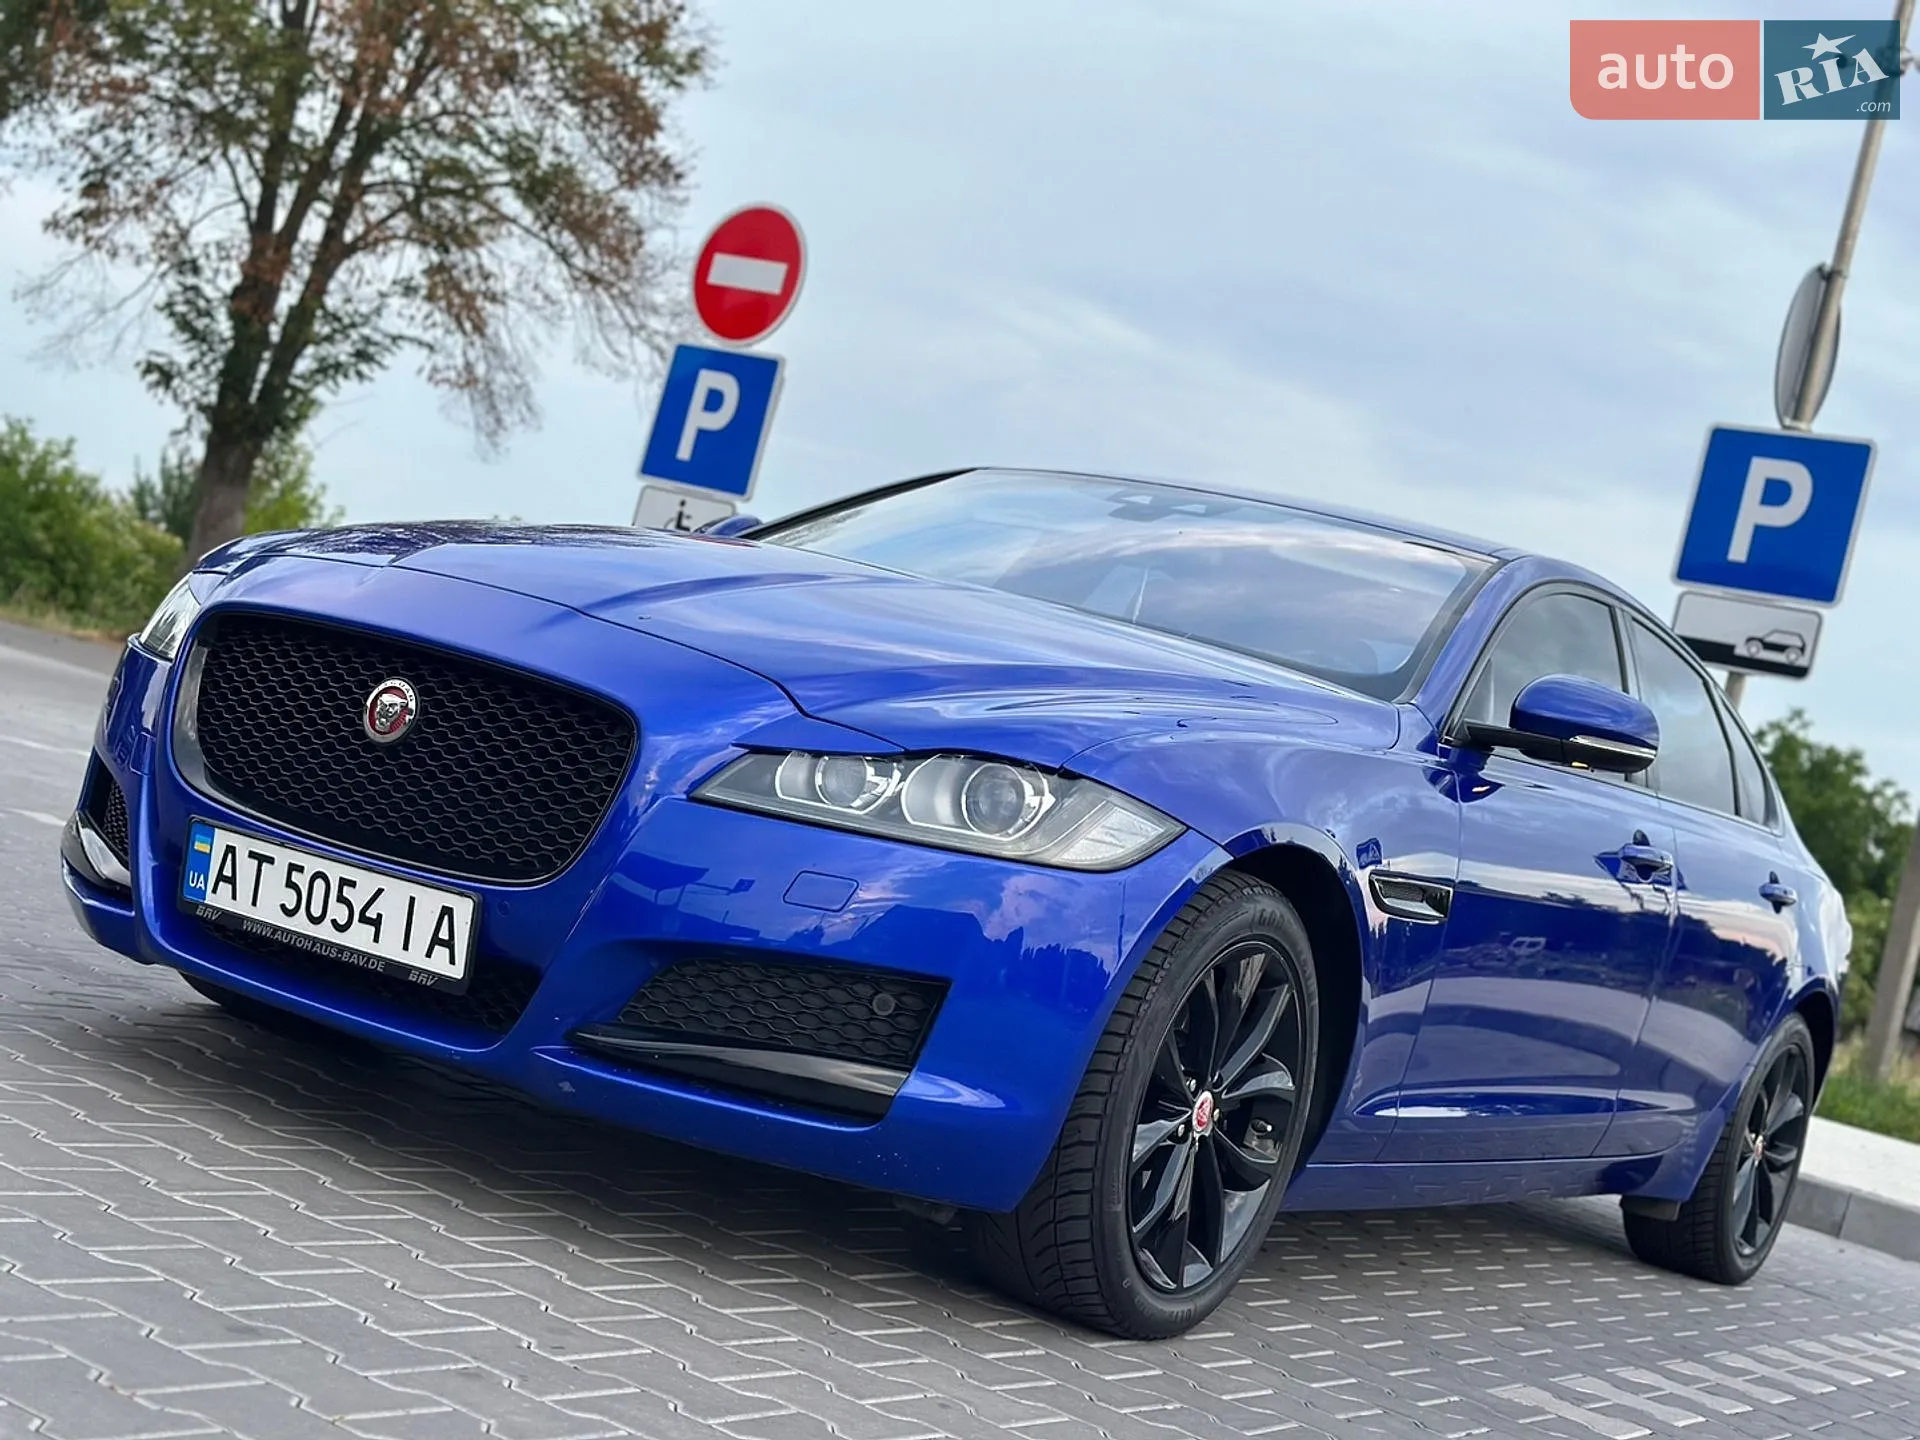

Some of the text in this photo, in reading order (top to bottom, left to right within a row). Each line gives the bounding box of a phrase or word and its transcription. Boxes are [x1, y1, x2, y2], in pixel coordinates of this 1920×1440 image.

[675, 368, 740, 462] P
[1727, 455, 1814, 564] P
[189, 871, 206, 891] UA
[211, 844, 456, 966] AT 5054 IA
[242, 919, 386, 973] WWW.AUTOHAUS-BAV.DE
